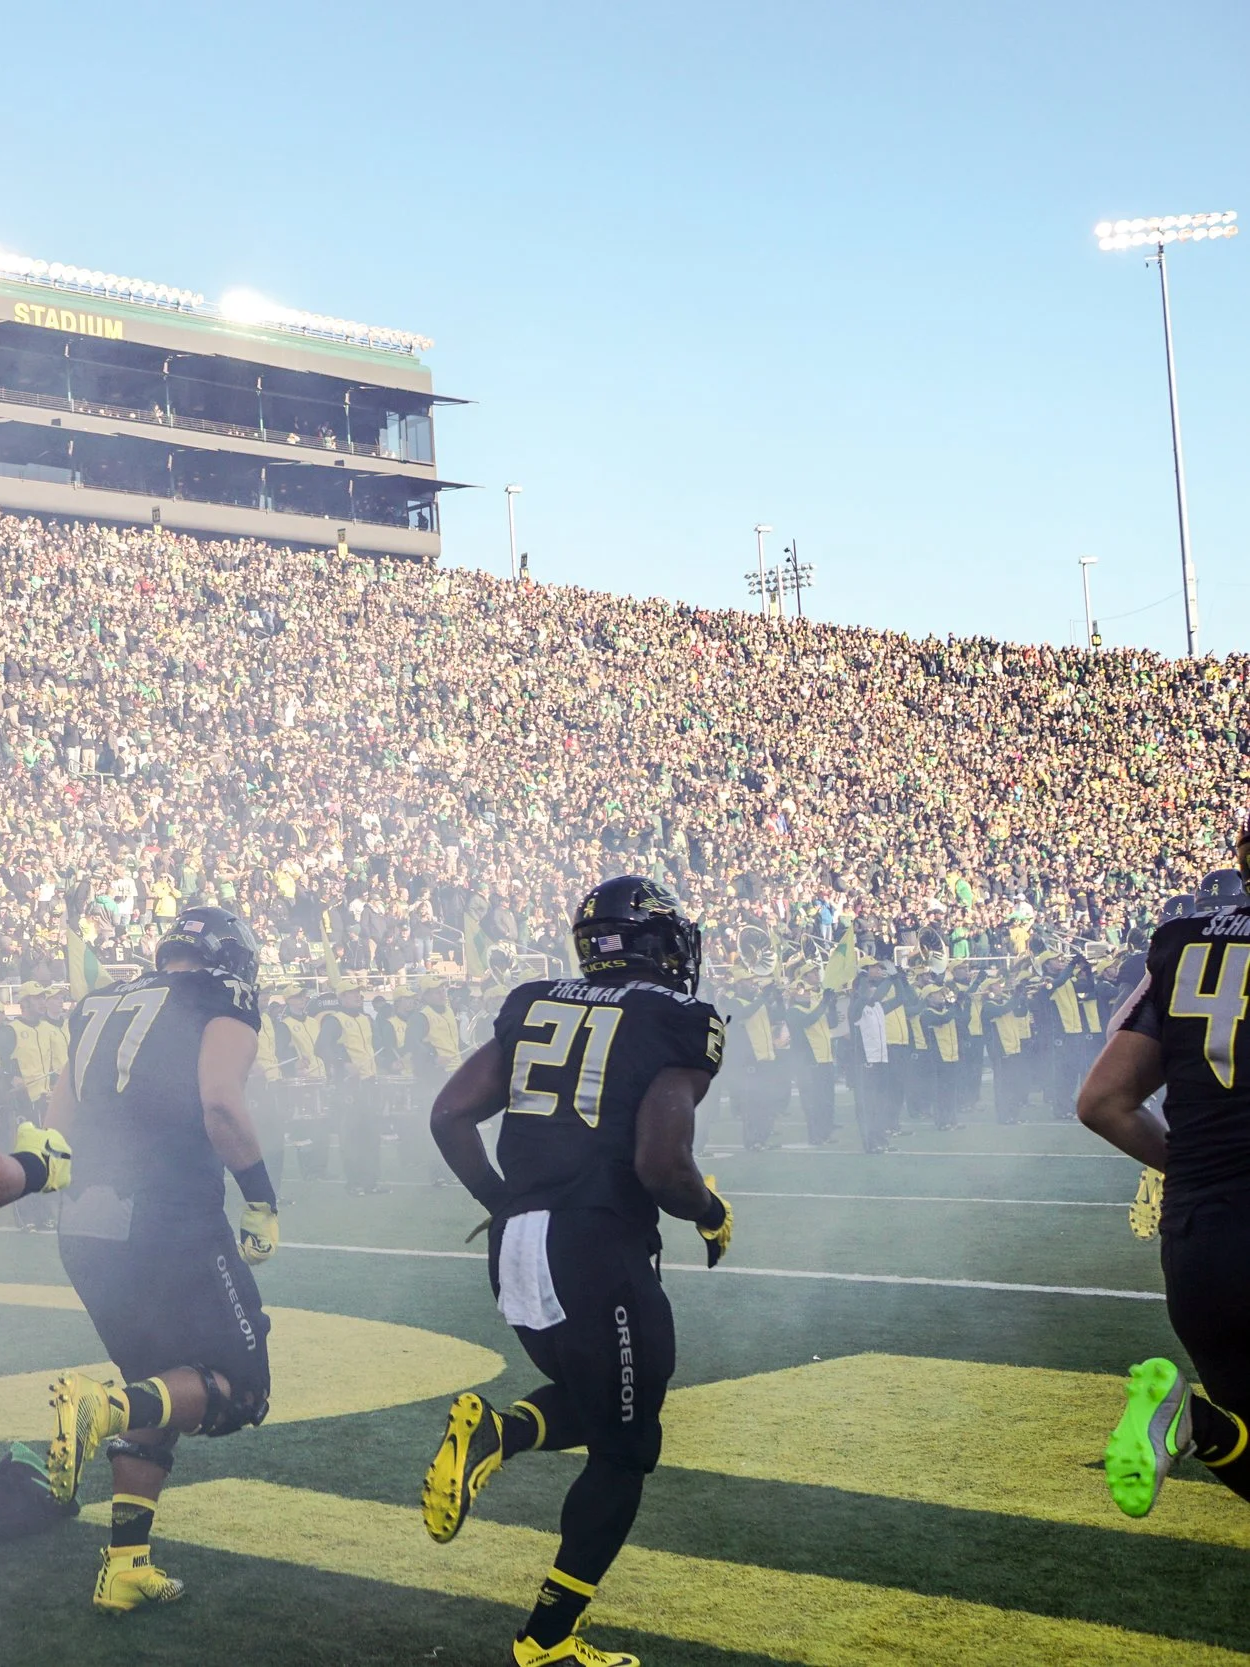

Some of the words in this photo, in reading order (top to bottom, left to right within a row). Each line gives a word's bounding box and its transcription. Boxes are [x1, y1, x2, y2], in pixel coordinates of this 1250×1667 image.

[14, 303, 124, 341] STADIUM
[74, 986, 170, 1102] 77
[547, 981, 628, 1003] FREEMAN
[507, 1000, 624, 1129] 21
[215, 1254, 257, 1351] OREGON
[613, 1304, 634, 1424] OREGON
